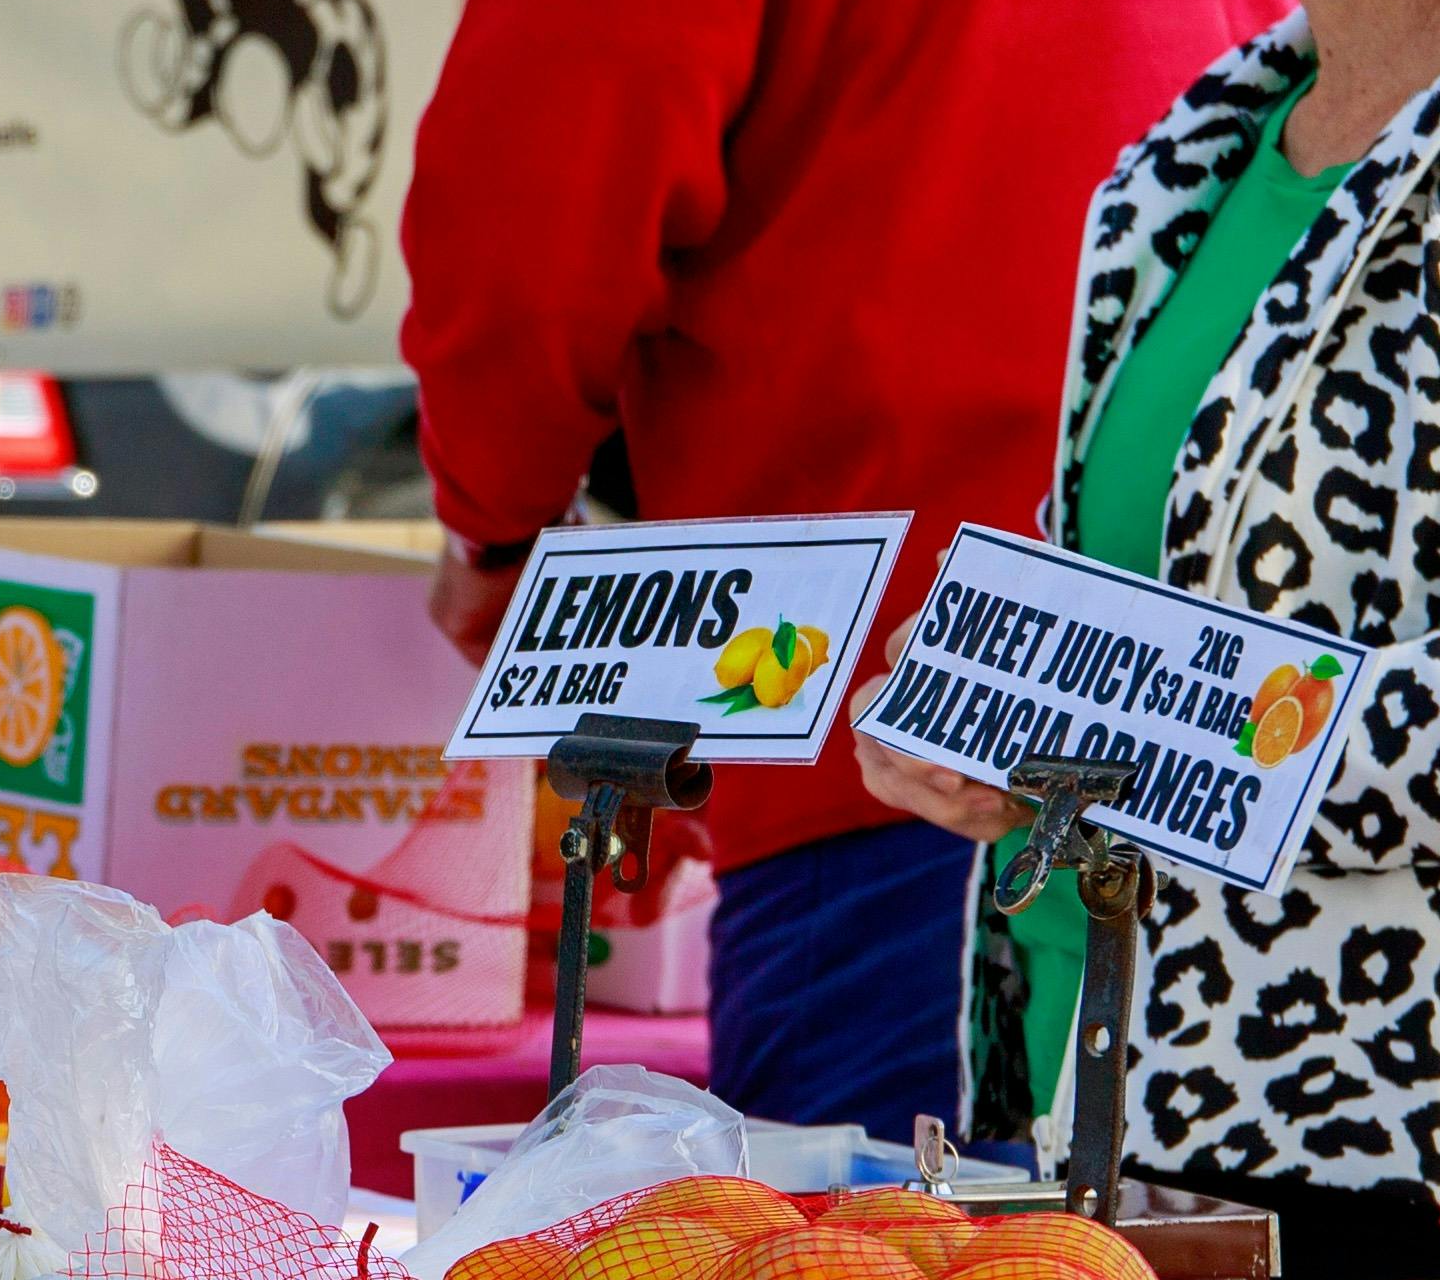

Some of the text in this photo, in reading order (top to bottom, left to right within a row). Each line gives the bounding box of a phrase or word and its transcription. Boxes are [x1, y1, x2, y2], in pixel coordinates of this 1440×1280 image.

[514, 568, 754, 653] LEMONS
[921, 580, 1164, 715] SWEET JUICY
[490, 661, 629, 712] $2 A BAG
[1188, 625, 1245, 680] 2KG
[879, 658, 1075, 771] VALENCIA
[1142, 666, 1253, 741] $3 A BAG
[154, 783, 489, 822] STANDARD
